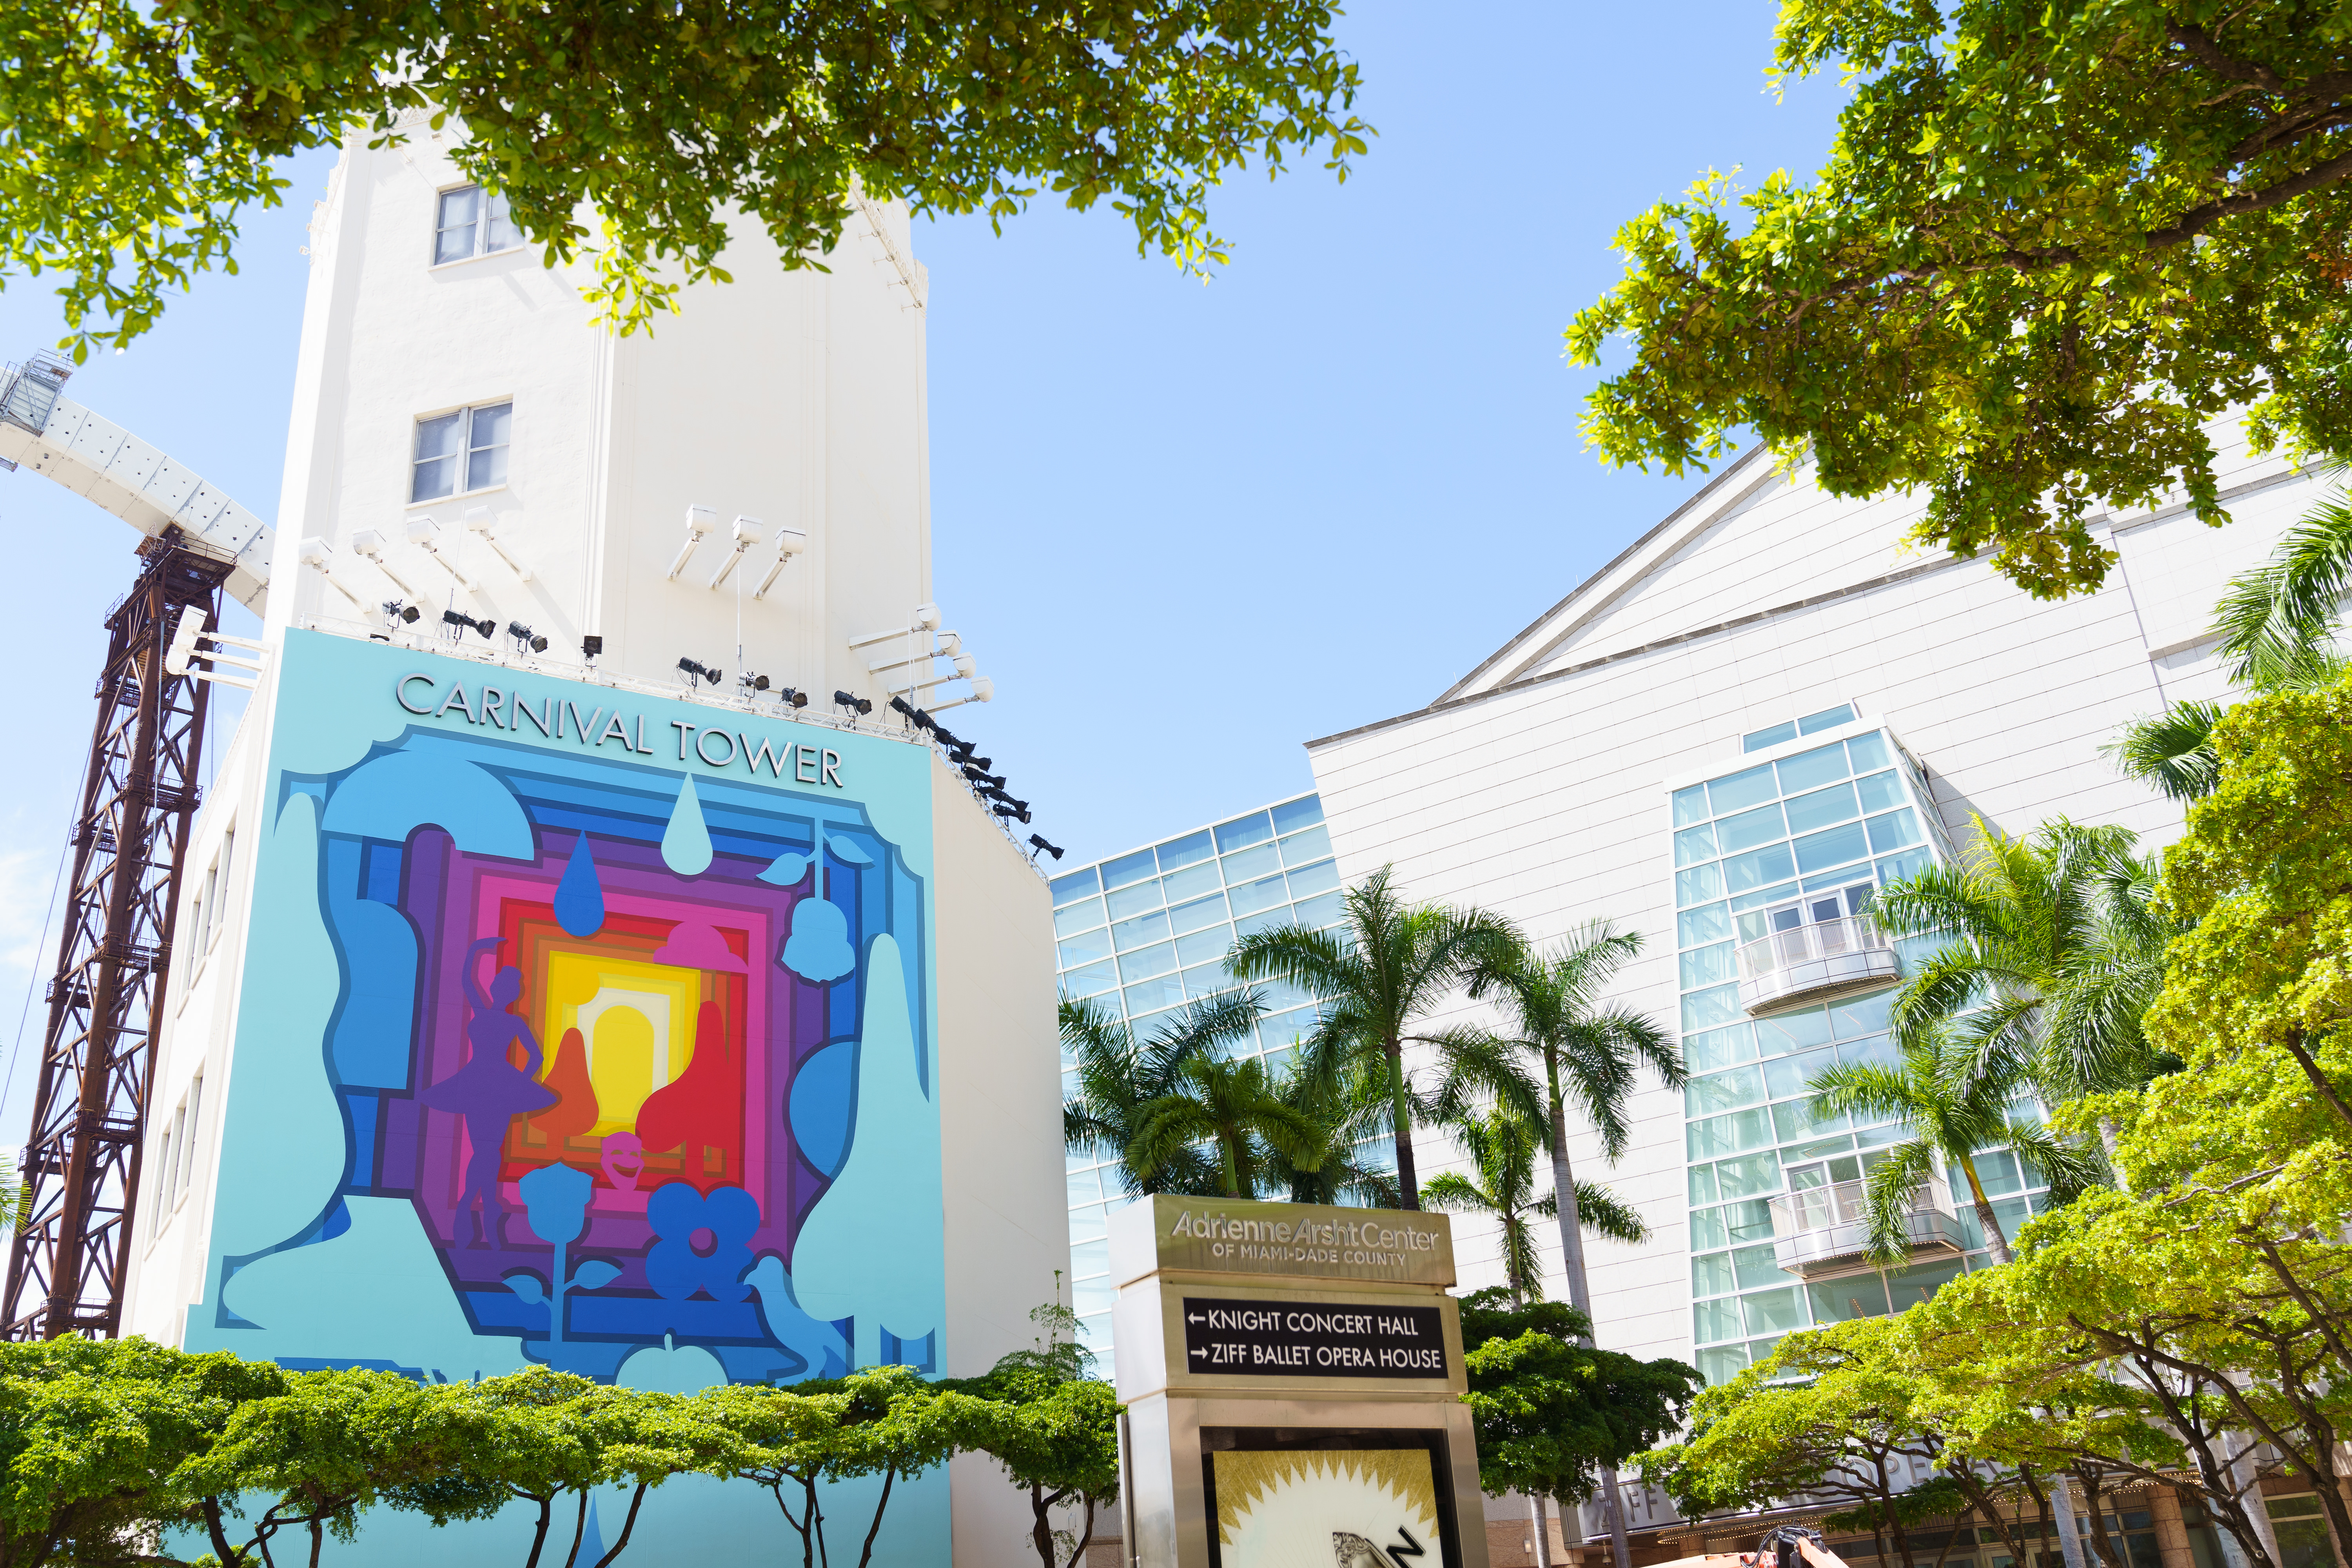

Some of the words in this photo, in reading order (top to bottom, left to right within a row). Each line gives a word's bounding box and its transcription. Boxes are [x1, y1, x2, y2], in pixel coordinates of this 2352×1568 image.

[396, 672, 653, 755] CARNIVAL
[671, 720, 844, 788] TOWER
[1171, 1210, 1291, 1243] Adrienne
[1292, 1218, 1359, 1247] Arsht
[1360, 1222, 1439, 1251] Center
[1212, 1242, 1234, 1258] OF
[1240, 1244, 1338, 1263] MIAMI-DADE
[1342, 1250, 1405, 1266] COUNTY
[1209, 1309, 1281, 1331] KNIGHT
[1287, 1312, 1372, 1334] CONCERT
[1378, 1316, 1419, 1336] HALL
[1211, 1343, 1247, 1363] ZIFF
[1253, 1344, 1310, 1365] BALLET
[1316, 1346, 1376, 1367] OPERA
[1379, 1348, 1441, 1368] HOUSE
[1598, 1488, 1658, 1526] FF
